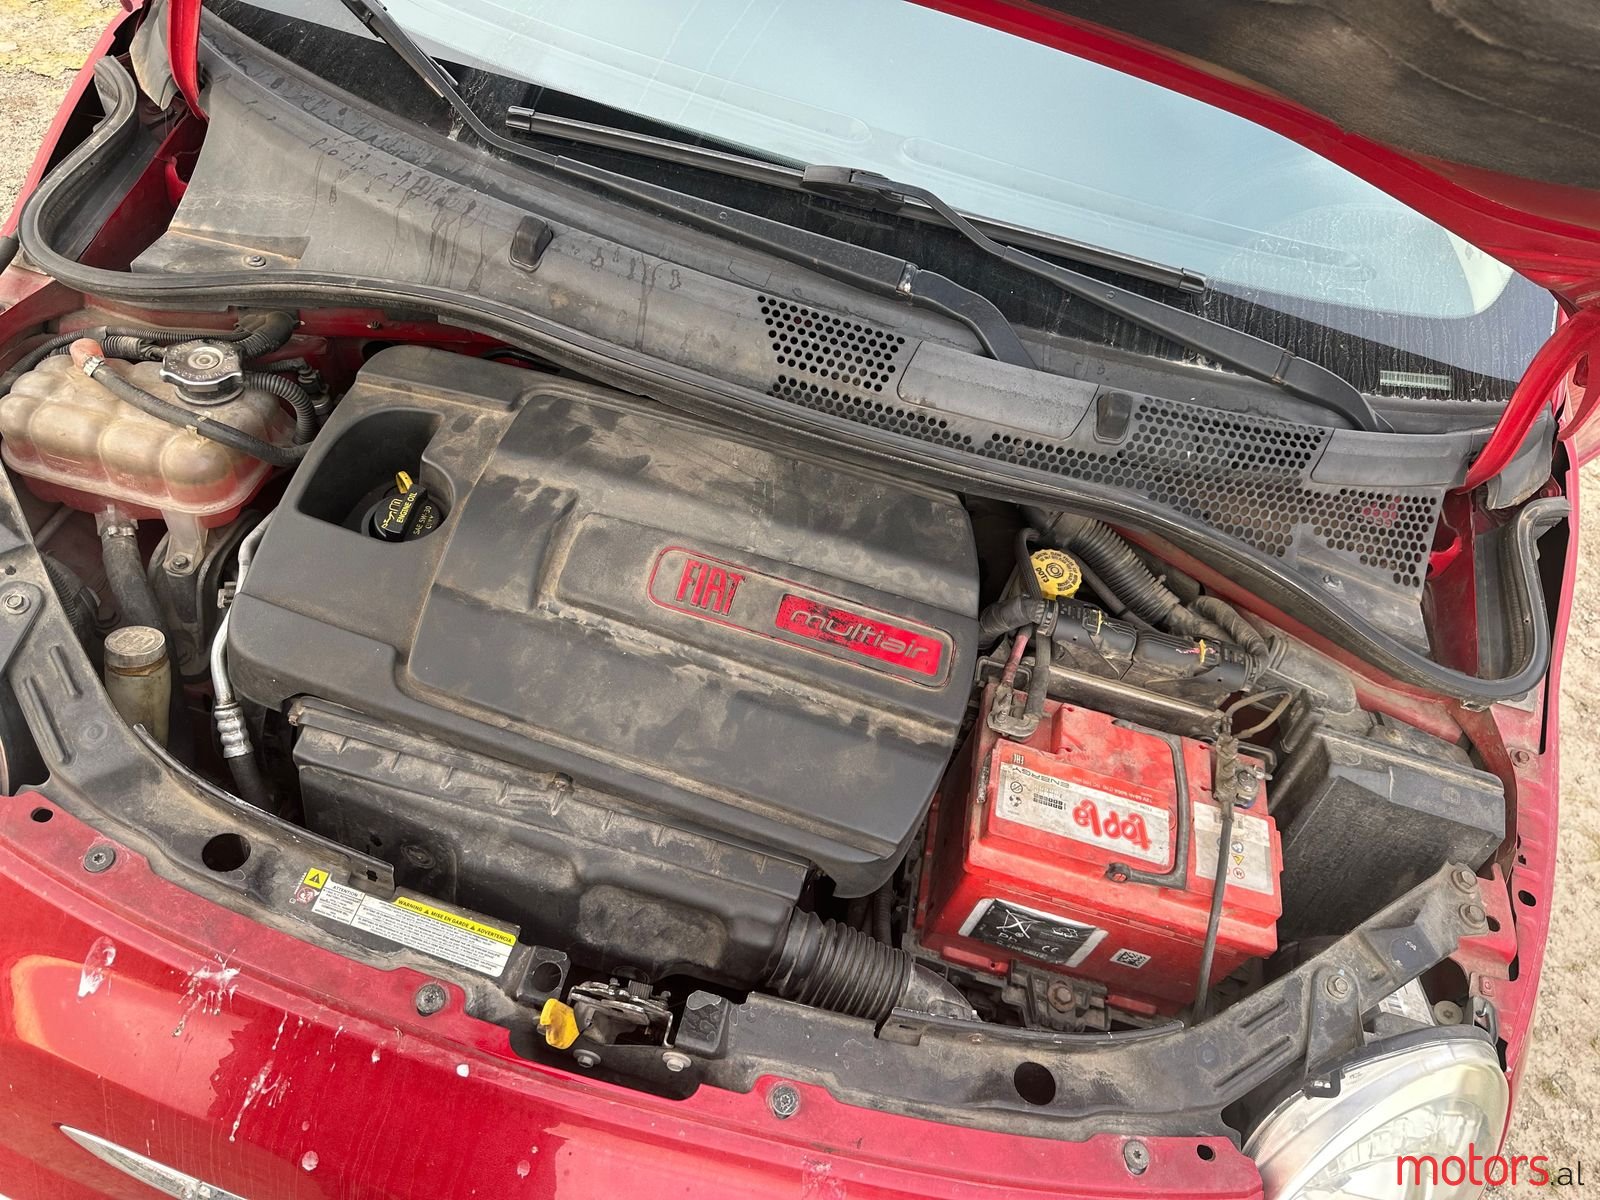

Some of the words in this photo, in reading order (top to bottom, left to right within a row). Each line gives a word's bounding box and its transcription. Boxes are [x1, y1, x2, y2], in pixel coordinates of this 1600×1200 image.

[396, 502, 412, 523] ENGINE
[407, 492, 418, 502] OIL
[413, 523, 423, 535] SAE
[1035, 567, 1049, 582] DOT3
[675, 558, 746, 616] FIAT
[790, 610, 929, 658] multiair
[1012, 766, 1070, 789] ENERGY
[1072, 799, 1152, 850] topla
[333, 885, 359, 897] ATTENTION
[398, 899, 423, 912] WARNING
[431, 911, 444, 920] MISE
[451, 918, 469, 928] GARDE
[477, 927, 512, 943] ADVERTENCIA
